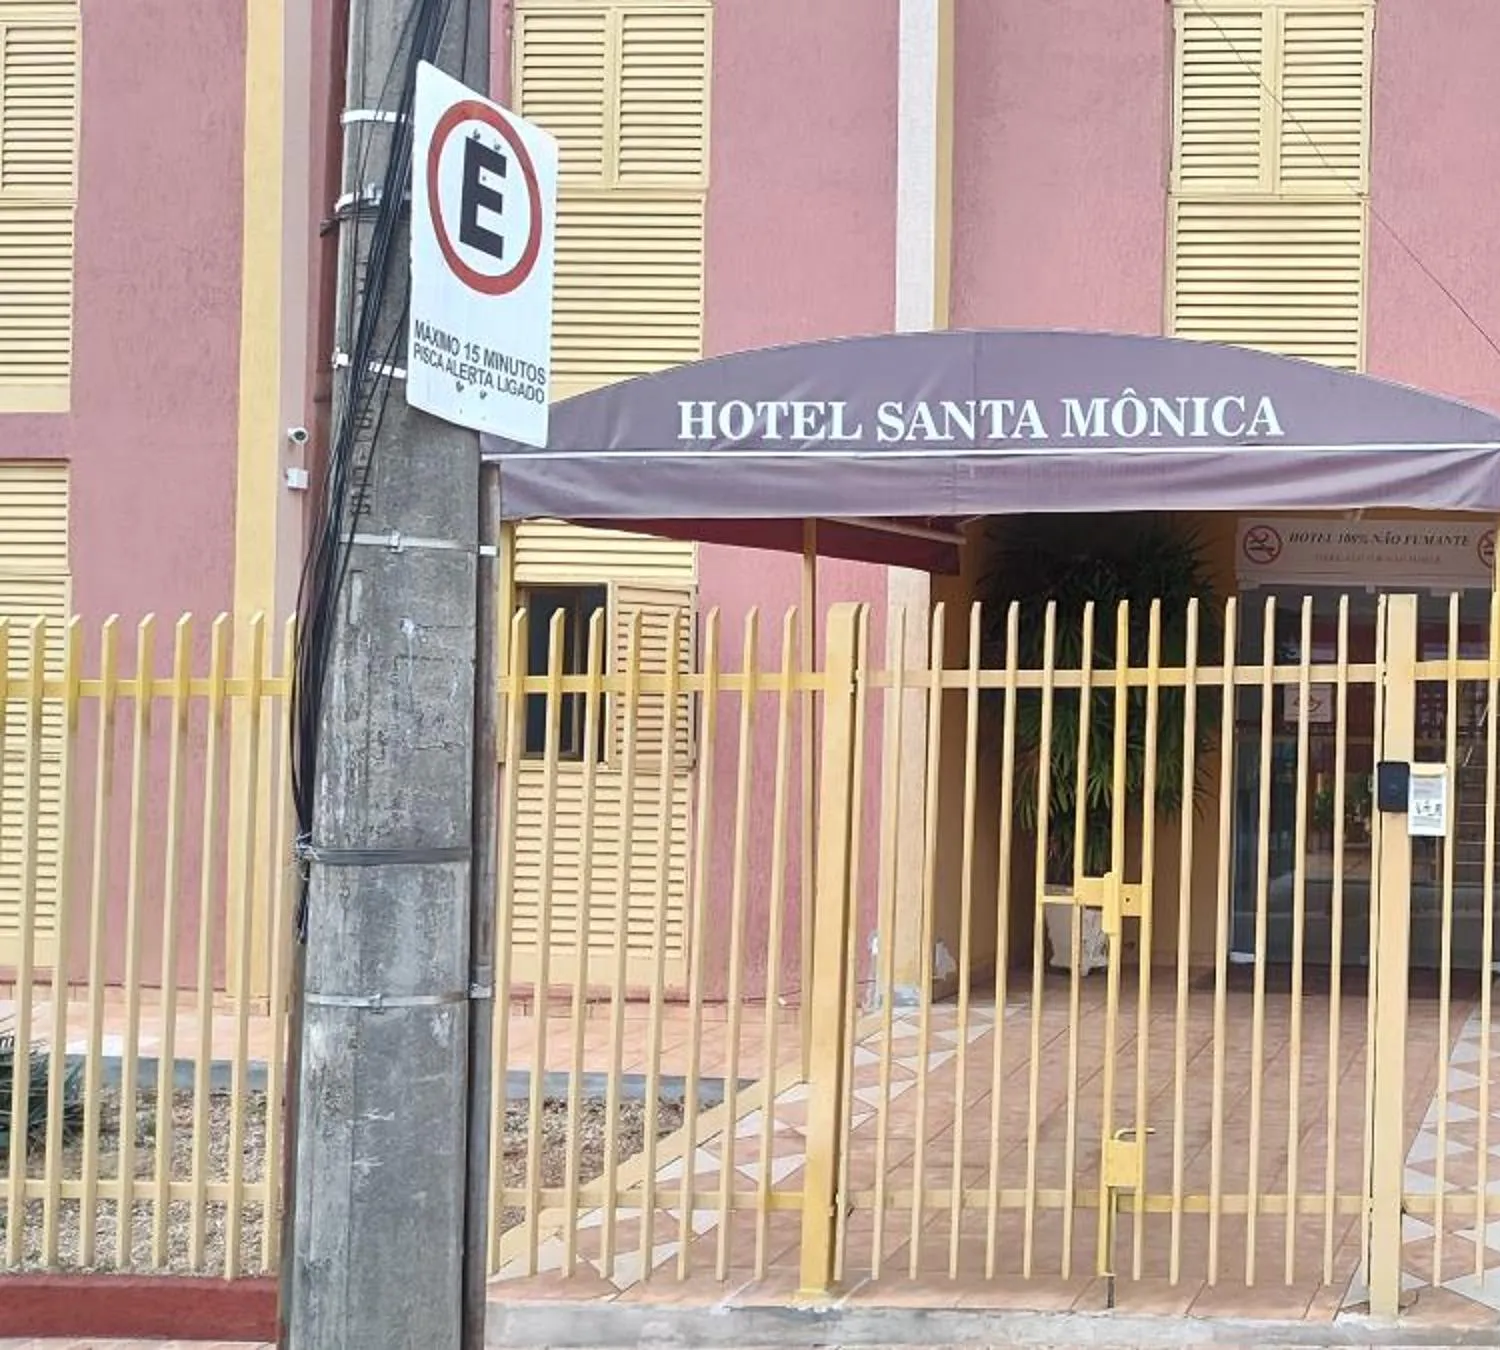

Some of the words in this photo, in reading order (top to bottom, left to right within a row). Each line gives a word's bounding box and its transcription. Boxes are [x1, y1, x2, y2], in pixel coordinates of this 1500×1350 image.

[459, 136, 507, 260] E
[413, 341, 444, 373] PISCA
[446, 357, 494, 389] ALERTA
[497, 375, 545, 404] LIGADO
[464, 342, 481, 363] 15
[484, 348, 547, 386] MINUTOS
[677, 399, 863, 441] HOTEL
[876, 399, 1048, 442] SANTA
[1061, 387, 1285, 438] MÔNICA
